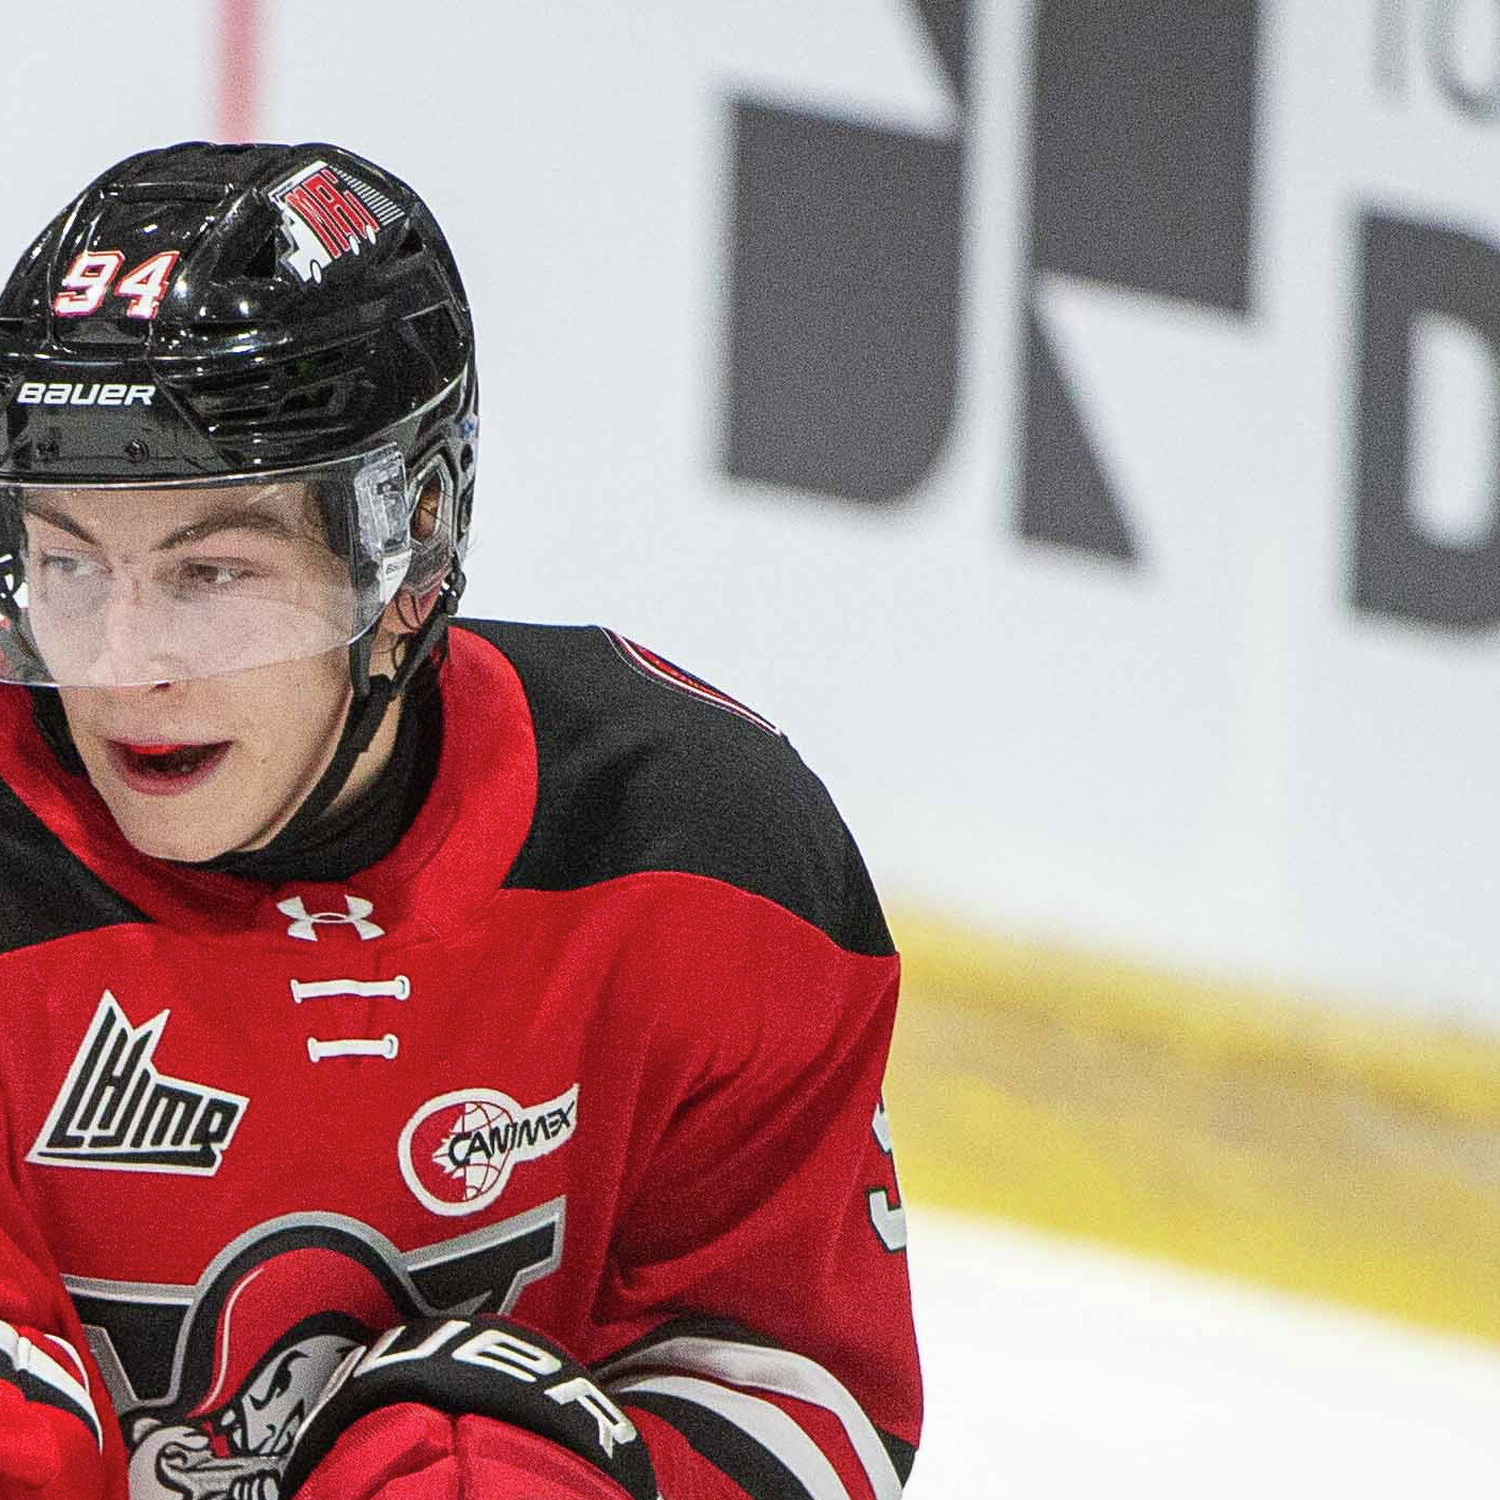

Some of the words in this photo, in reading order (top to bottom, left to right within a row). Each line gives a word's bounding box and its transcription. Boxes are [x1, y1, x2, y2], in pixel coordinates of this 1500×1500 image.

[53, 250, 181, 320] 94
[16, 382, 156, 406] BAUER
[448, 1101, 576, 1166] CANIMEX
